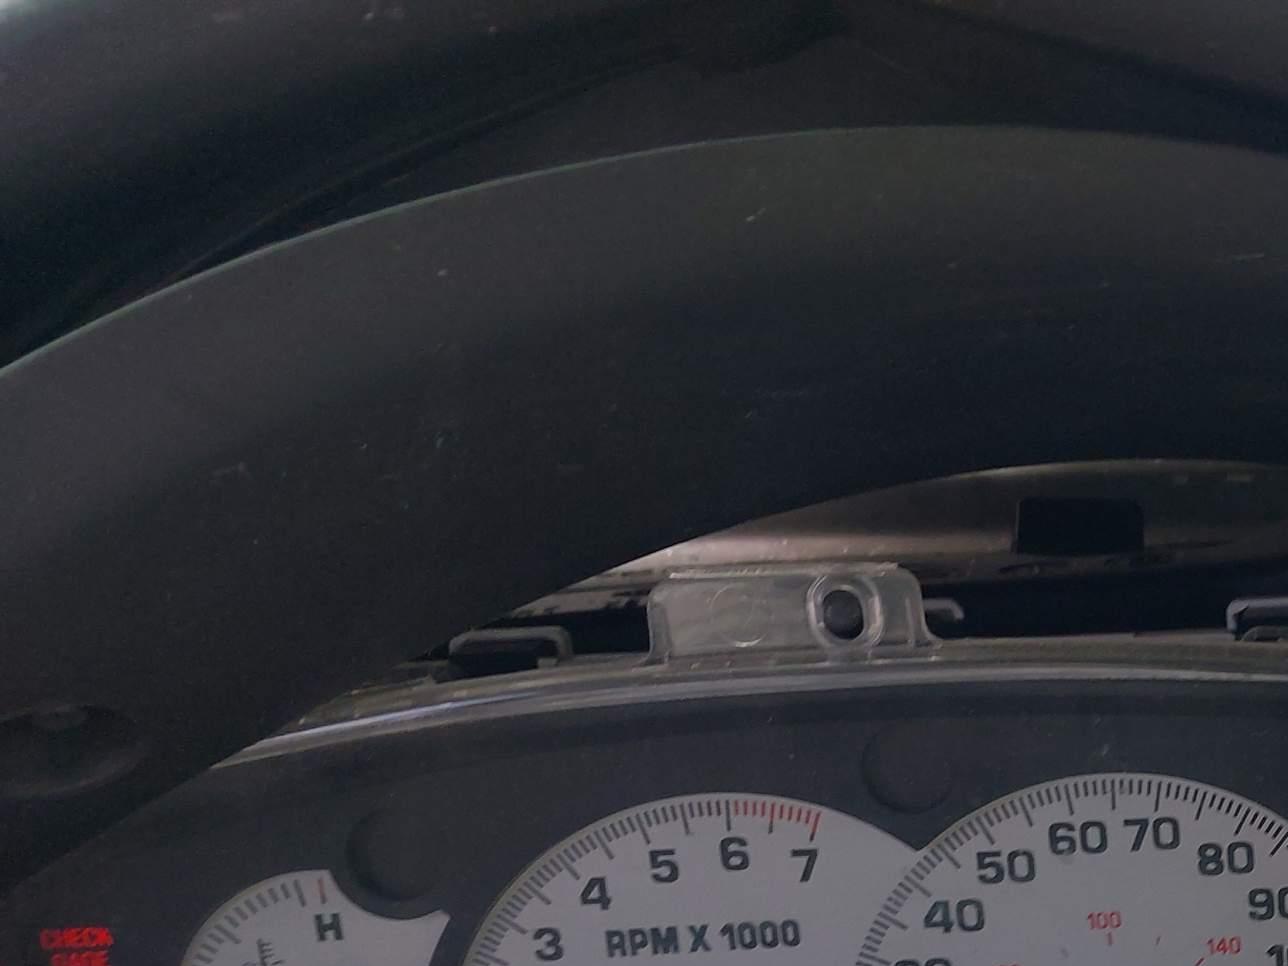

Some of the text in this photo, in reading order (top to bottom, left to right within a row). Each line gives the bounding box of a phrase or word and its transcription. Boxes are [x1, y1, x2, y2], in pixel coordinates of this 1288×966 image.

[1048, 821, 1107, 855] 60
[1124, 817, 1180, 851] 70
[649, 848, 679, 883] 5
[720, 837, 750, 871] 6
[791, 848, 819, 882] 7
[976, 850, 1035, 884] 50
[1198, 842, 1254, 876] 80
[580, 877, 612, 911] 4
[314, 913, 343, 942] H
[924, 898, 984, 933] 40
[1087, 911, 1123, 931] 100
[534, 928, 563, 961] 3
[605, 919, 801, 958] RPM X 1000
[1207, 936, 1242, 956] 140
